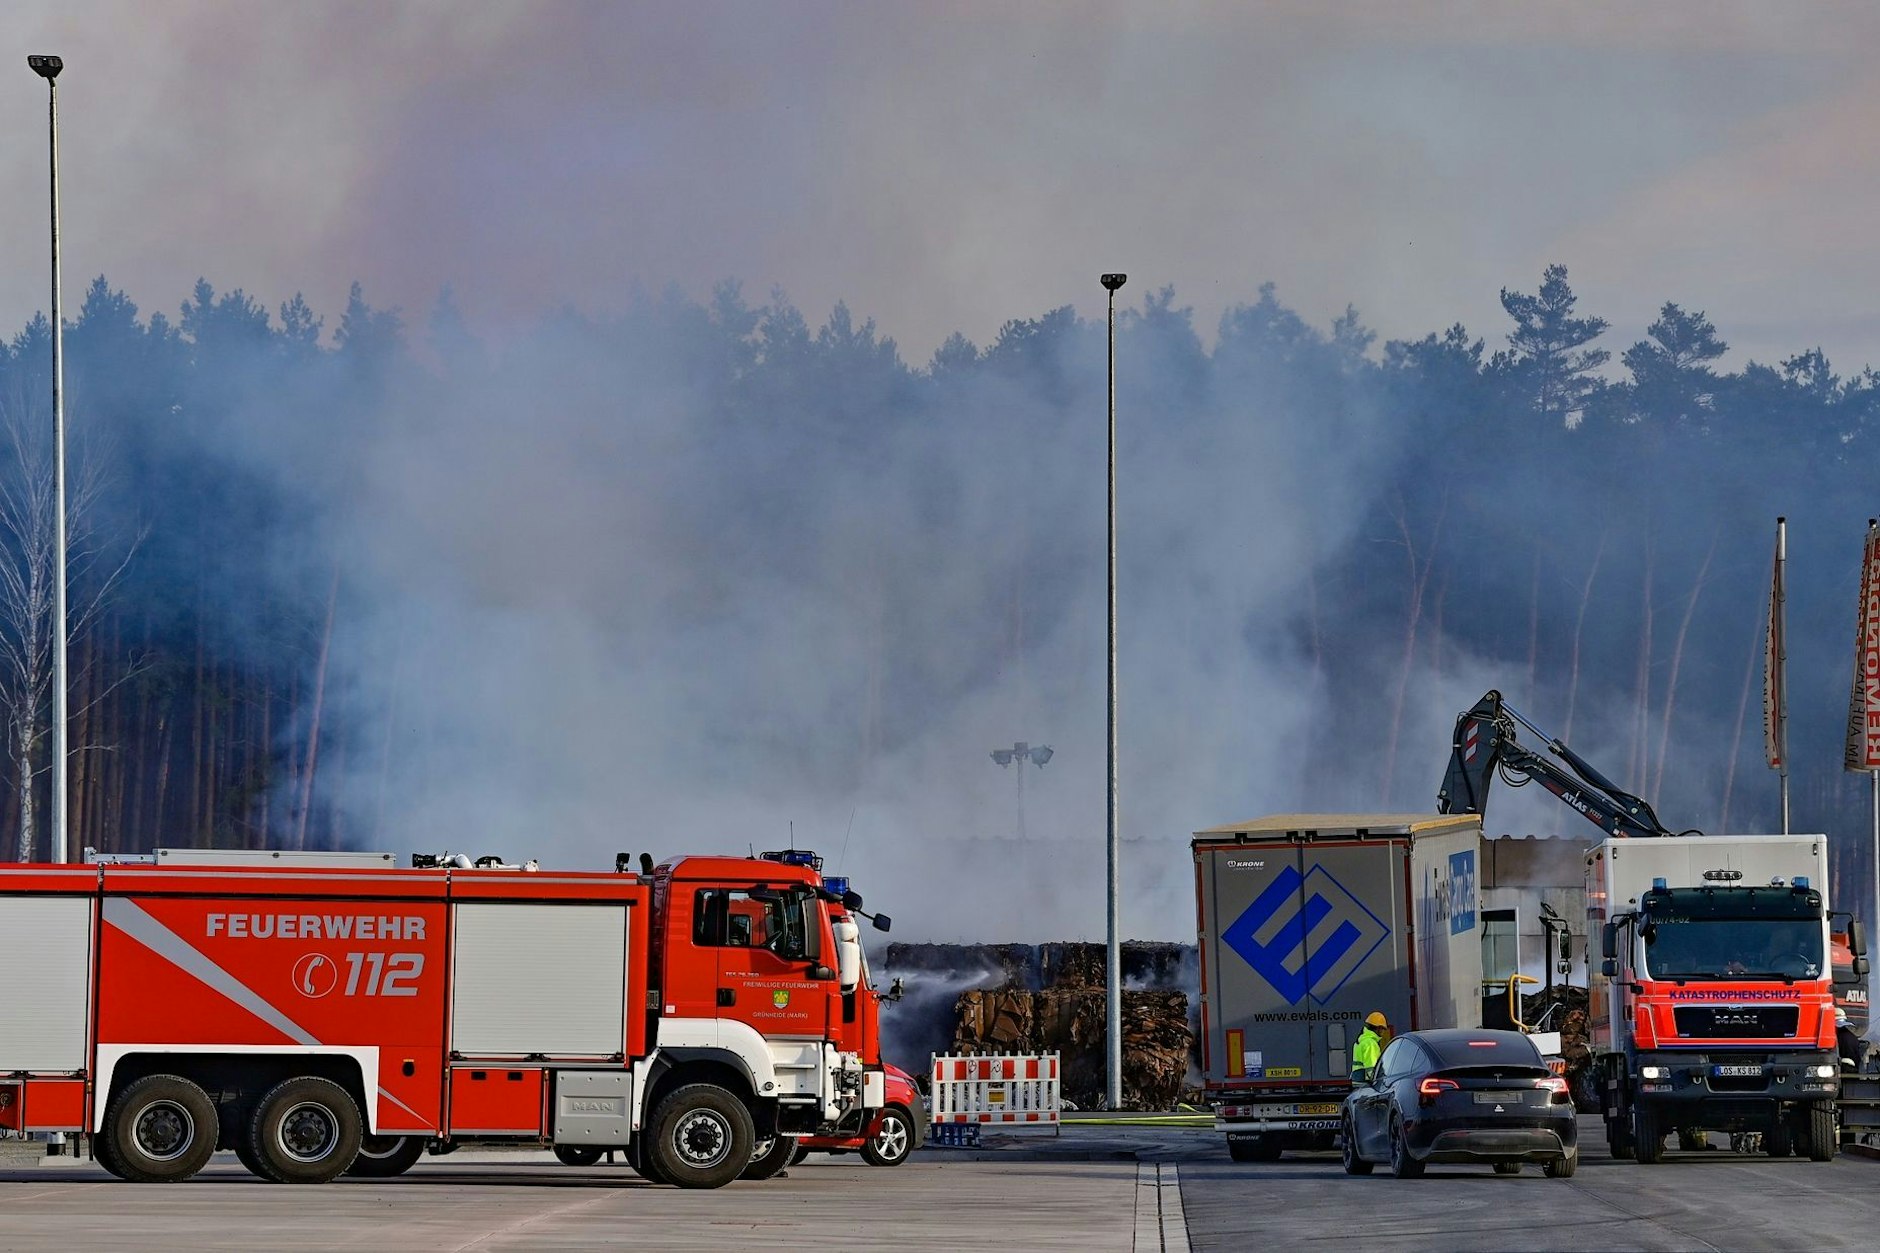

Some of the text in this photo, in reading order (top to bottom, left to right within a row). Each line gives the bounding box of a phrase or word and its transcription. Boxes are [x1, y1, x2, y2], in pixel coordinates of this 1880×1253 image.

[1561, 791, 1588, 812] ATLAS
[206, 913, 427, 940] FEUERWEHR
[344, 952, 425, 997] 112
[743, 981, 780, 989] FREIWILLIGE
[1669, 990, 1800, 1000] KATASTROPHENSCHUTZ
[752, 1010, 808, 1019] GRÜNHEIDE (MARK)
[1254, 1010, 1362, 1022] www.ewals.com
[1715, 1015, 1758, 1024] MAN
[572, 1102, 614, 1111] MAN
[1299, 1120, 1343, 1130] KRONE
